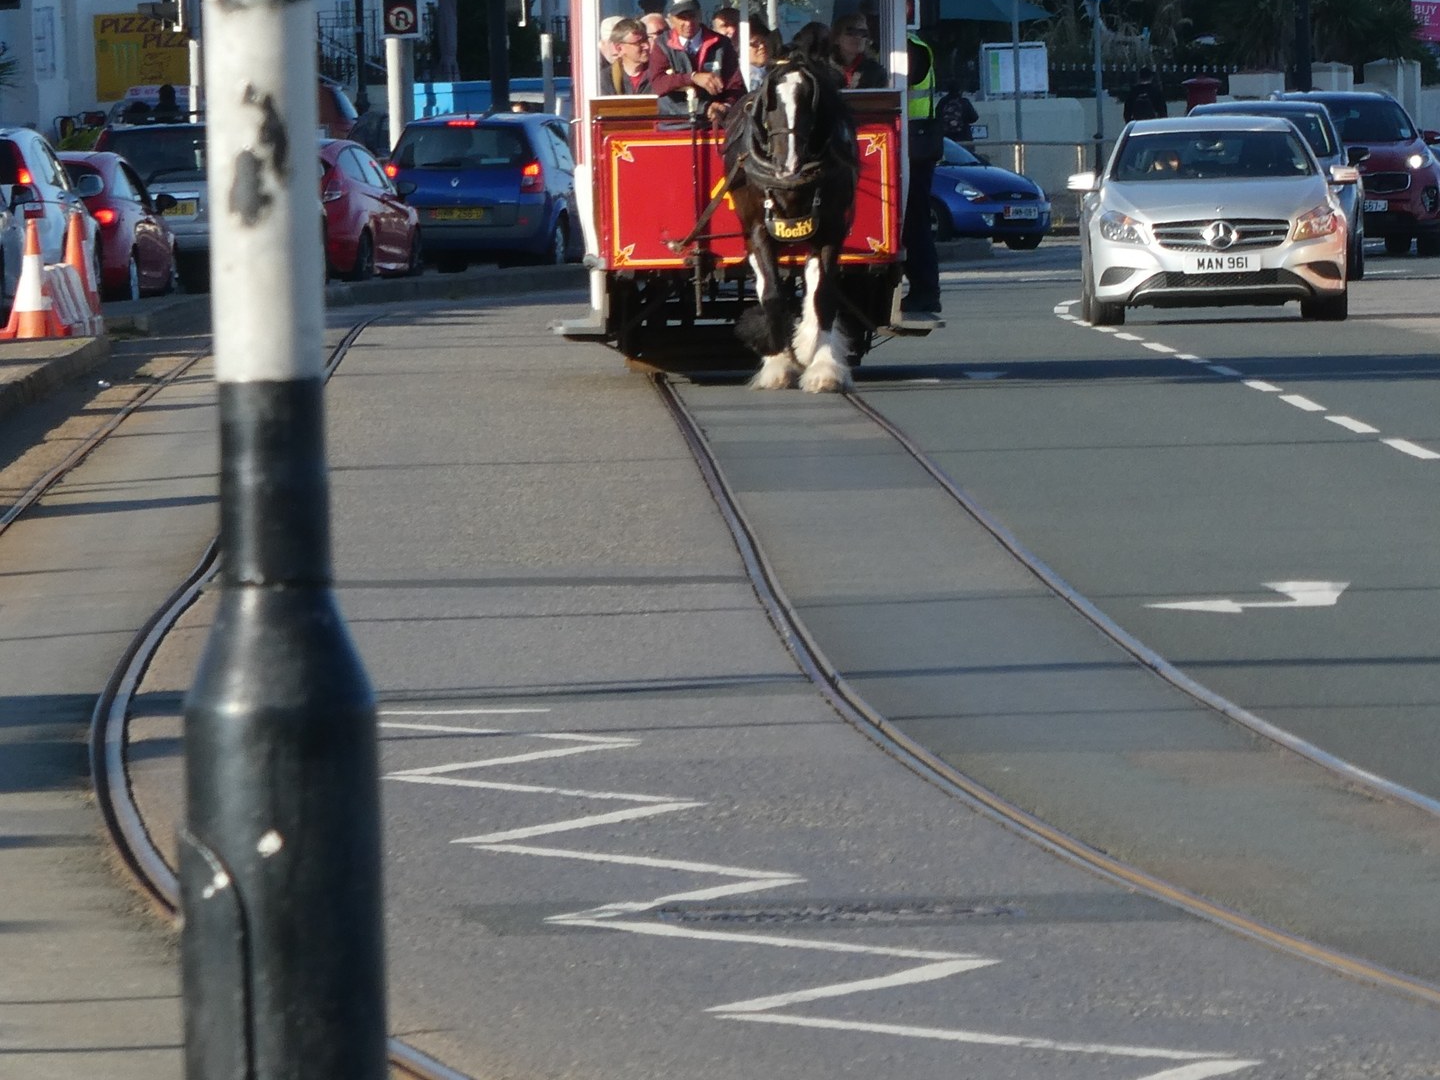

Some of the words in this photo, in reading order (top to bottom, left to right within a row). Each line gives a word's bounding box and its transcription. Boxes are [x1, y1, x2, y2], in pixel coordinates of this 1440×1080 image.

[1414, 4, 1437, 15] BUY
[1197, 257, 1223, 270] MAN
[1227, 256, 1248, 269] 961
